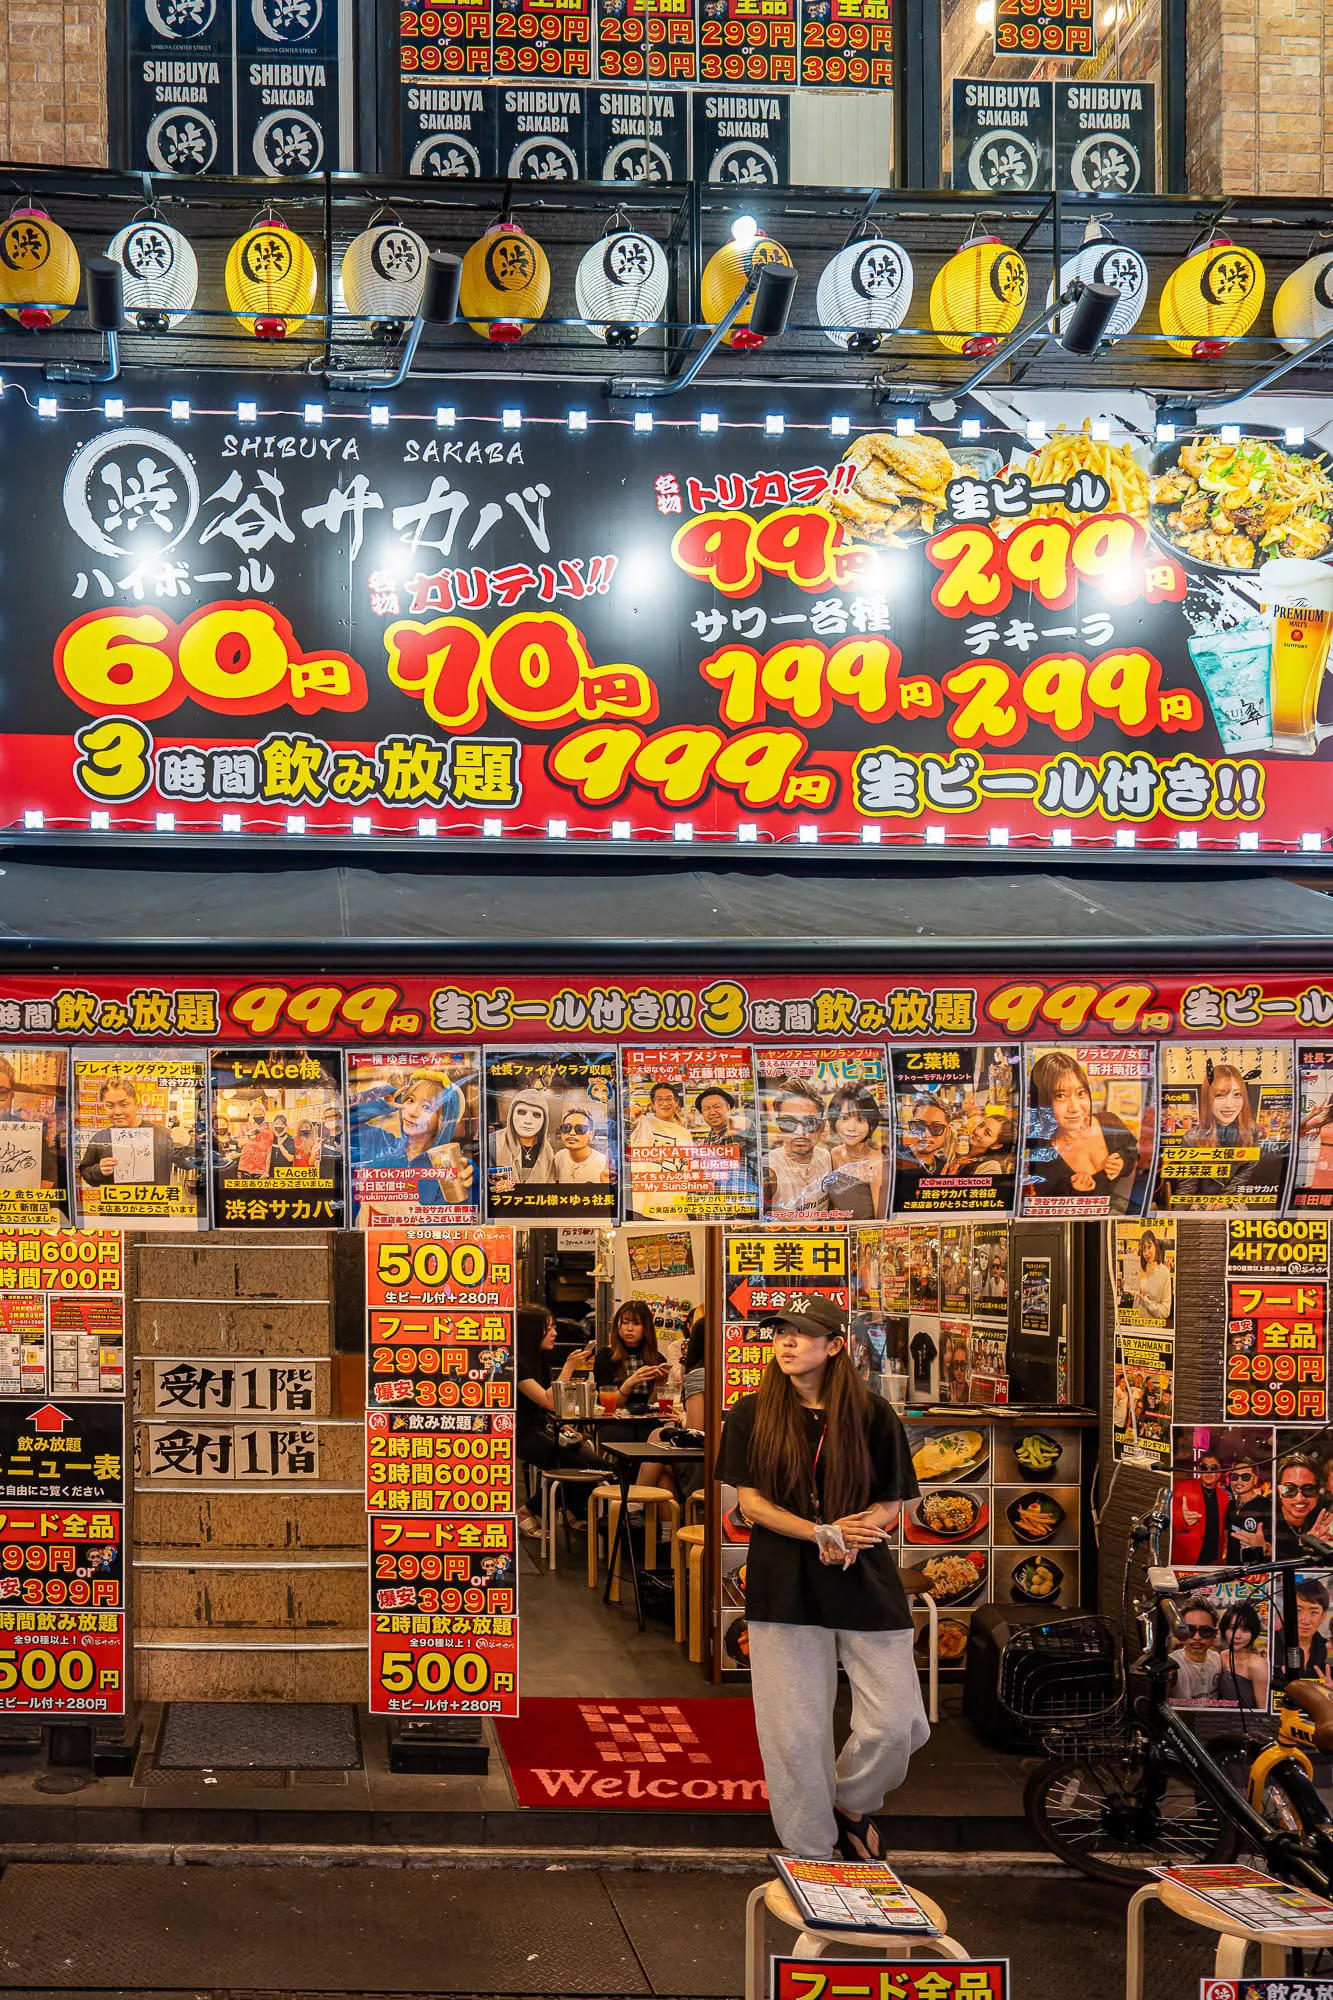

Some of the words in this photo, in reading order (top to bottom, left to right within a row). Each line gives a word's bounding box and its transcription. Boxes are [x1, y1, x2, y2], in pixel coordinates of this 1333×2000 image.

[400, 11, 491, 39] 299円
[495, 12, 590, 43] 299円
[600, 17, 694, 45] 299円
[701, 20, 796, 48] 299円
[804, 21, 893, 52] 299円
[998, 22, 1092, 53] 399円
[400, 46, 491, 73] 399円
[495, 46, 590, 75] 399円
[600, 50, 697, 79] 399円
[701, 54, 796, 81] 399円
[803, 55, 893, 86] 399円
[143, 61, 220, 84] SHIBUYA
[250, 63, 326, 87] SHIBUYA
[155, 86, 207, 103] SAKABA
[262, 89, 314, 106] SAKABA
[408, 88, 484, 112] SHIBUYA
[505, 90, 581, 114] SHIBUYA
[599, 93, 675, 118] SHIBUYA
[965, 85, 1041, 108] SHIBUYA
[1067, 88, 1143, 111] SHIBUYA
[706, 97, 781, 121] SHIBUYA
[977, 109, 1029, 127] SAKABA
[419, 113, 472, 131] SAKABA
[517, 115, 569, 133] SAKABA
[611, 118, 663, 136] SAKABA
[717, 121, 769, 139] SAKABA
[1079, 113, 1131, 130] SAKABA
[221, 434, 361, 460] SHIBUYA
[404, 440, 525, 465] SAKABA
[654, 471, 683, 515] 名物
[950, 473, 1106, 520] 生ビール
[100, 455, 552, 562] 渋谷サカバ
[674, 507, 875, 591] 99円
[932, 518, 1174, 611] 299円
[72, 558, 275, 601] ハイボール
[691, 595, 892, 645] サワー各種
[1273, 604, 1325, 623] PREMIUM
[964, 612, 1115, 656] テキーラ
[60, 605, 354, 708] 60円
[387, 611, 652, 728] 70円
[709, 641, 934, 724] 199円
[947, 658, 1193, 740] 299円
[78, 719, 518, 803] 3時間飲み放題
[555, 727, 837, 806] 999円
[858, 752, 1261, 817] 生ビール付き!!
[0, 990, 216, 1034] 時間飲み放題
[232, 986, 421, 1033] 999円
[435, 990, 694, 1031] 生ビール付き!!
[702, 984, 973, 1034] 3時間飲み放題
[989, 985, 1169, 1031] 999円
[633, 1051, 742, 1063] ロードオブメジャー
[768, 1050, 874, 1058] ヤングアニマルグランプリ
[906, 1053, 961, 1070] 乙葉様
[232, 1059, 321, 1080] t-Ace様
[490, 1064, 612, 1076] 社長ファイトクラブ収録
[817, 1060, 884, 1080] パピコ
[158, 1077, 205, 1088] 渋谷サカバ
[1165, 1148, 1235, 1160] セクシー女優
[276, 1168, 318, 1178] t-Ace様
[1217, 1165, 1229, 1177] 様
[15, 1190, 65, 1199] 金ちゃん様
[104, 1186, 180, 1201] にっけん君
[226, 1180, 332, 1188] ご来店ありがとうございました
[922, 1189, 967, 1199] 渋谷サカバ
[970, 1188, 997, 1198] 渋谷店
[20, 1203, 48, 1212] 新宿店
[90, 1204, 195, 1213] ご来店ありがとうございます
[903, 1199, 1005, 1209] ご来店ありがとうございました
[1171, 1195, 1277, 1204] ご来店ありがとうございました
[1230, 1220, 1328, 1240] 3H600円
[0, 1240, 121, 1264] 時間600円
[735, 1241, 841, 1273] 営業中
[1230, 1243, 1327, 1263] 4H700円
[376, 1242, 511, 1287] 500円
[0, 1267, 120, 1290] 時間700円
[385, 1291, 499, 1305] 生ビール付+280円
[751, 1291, 845, 1308] 渋谷バ
[1239, 1288, 1318, 1314] フード
[378, 1316, 506, 1342] フード全品
[1263, 1322, 1317, 1349] 全品
[373, 1347, 469, 1375] 299円
[1227, 1354, 1325, 1382] 299円
[157, 1363, 313, 1411] 受付1階
[374, 1380, 414, 1401] 爆安
[415, 1381, 511, 1408] 399円
[1227, 1389, 1325, 1417] 399円
[409, 1415, 473, 1430] 飲み放題
[17, 1436, 82, 1453] 飲み放題
[152, 1428, 316, 1476] 受付1階
[370, 1437, 511, 1459] 2時間500円
[0, 1453, 122, 1481] ニュー表
[370, 1462, 511, 1486] 3時間600円
[0, 1485, 105, 1496] ご自由にご覧ください
[369, 1489, 511, 1512] 4時間700円
[380, 1523, 508, 1548] フード全品
[0, 1545, 76, 1572] 99円
[375, 1554, 470, 1581] 299円
[22, 1578, 119, 1606] 399円
[377, 1587, 416, 1609] 爆安
[417, 1588, 513, 1614] 399円
[0, 1612, 118, 1632] 時間飲み放題
[376, 1615, 513, 1636] 2時間飲み放題
[380, 1652, 514, 1694] 500円
[388, 1699, 502, 1712] 生ビール付+280円
[791, 1971, 994, 2000] フード全品
